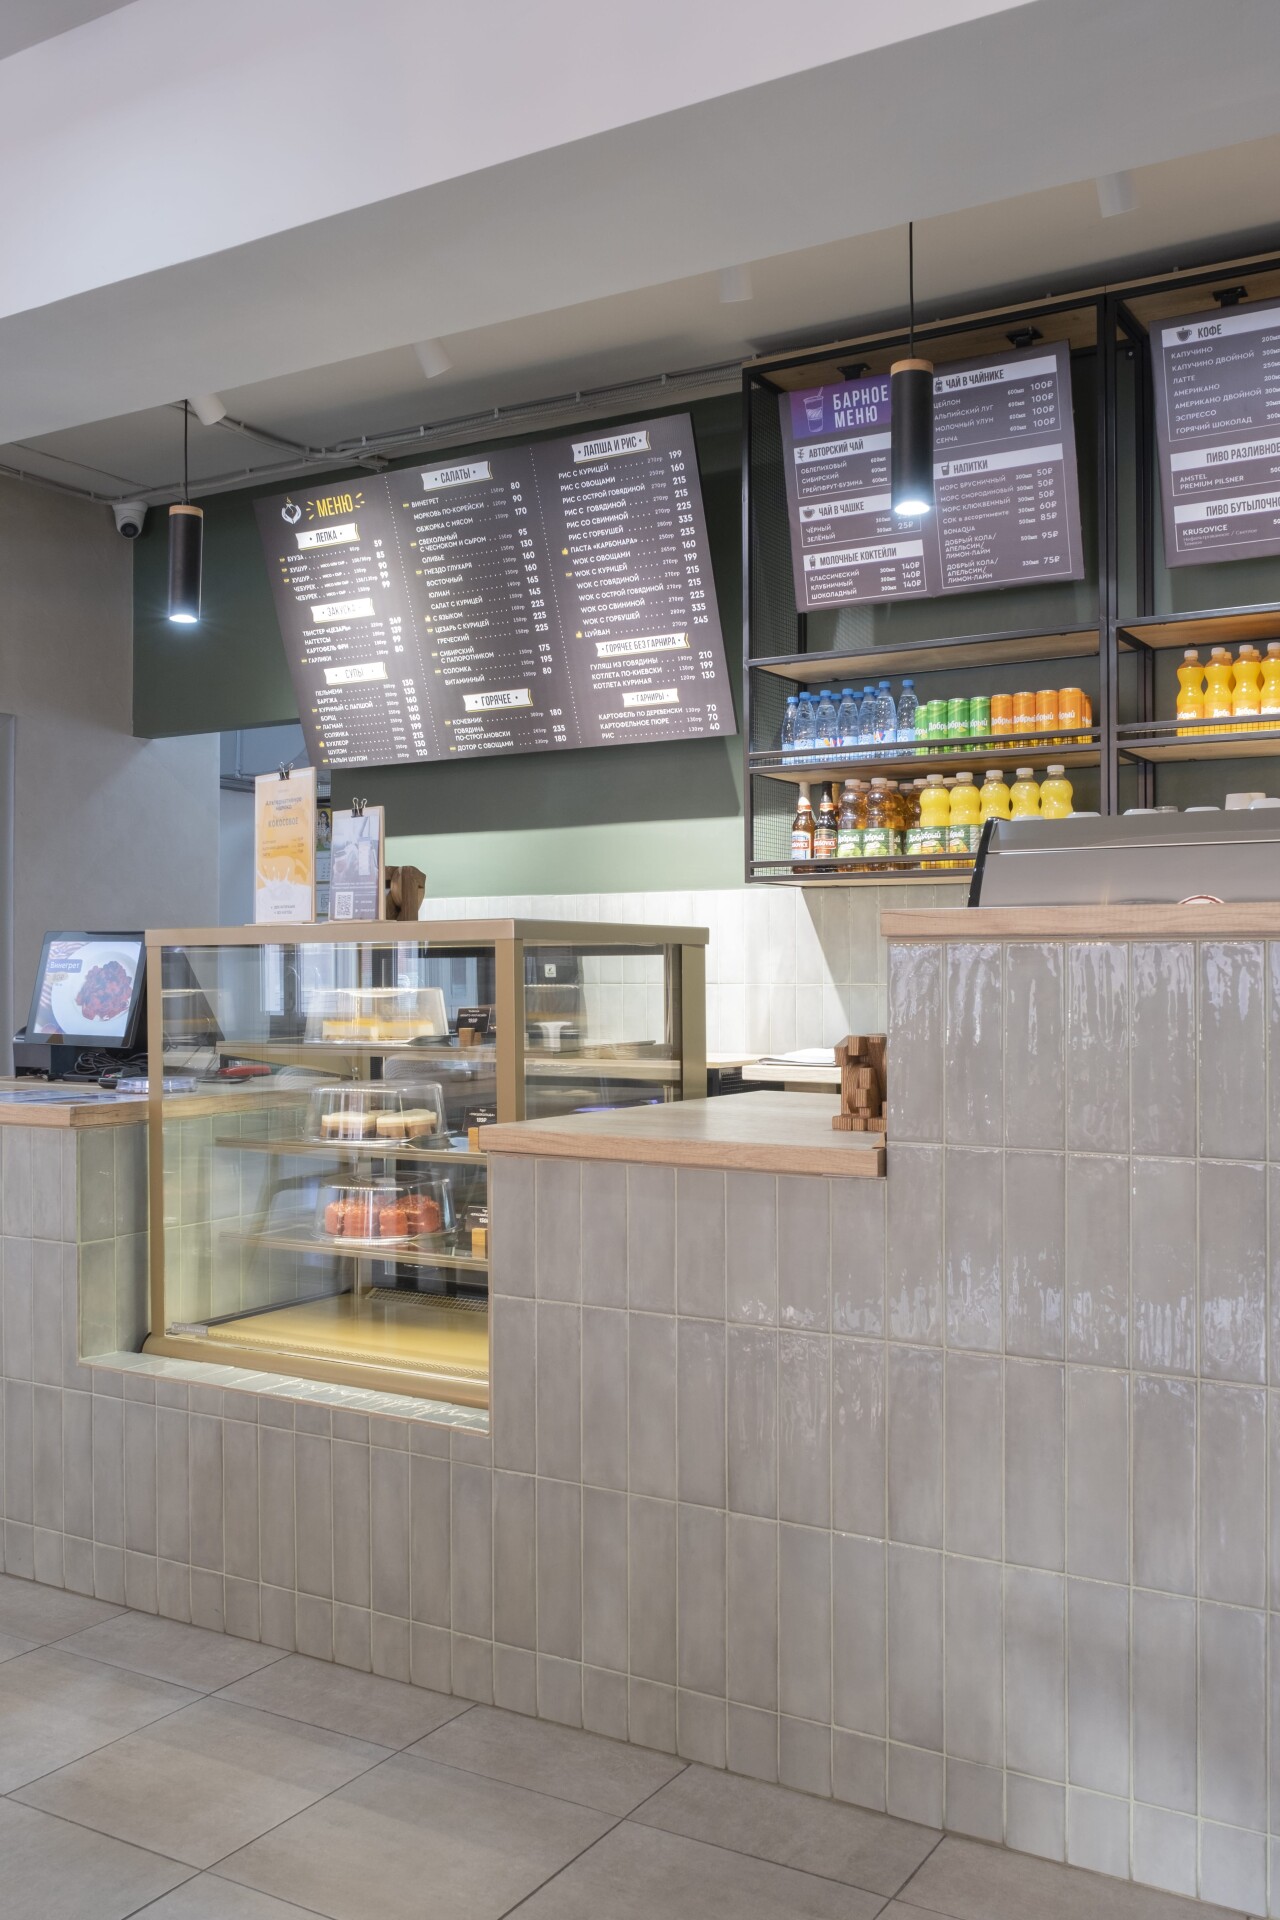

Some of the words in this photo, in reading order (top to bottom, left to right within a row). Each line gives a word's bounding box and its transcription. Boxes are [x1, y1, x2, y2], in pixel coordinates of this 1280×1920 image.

[1198, 324, 1222, 338] КОФЕ
[1171, 346, 1213, 359] КАПУЧИНО
[1172, 359, 1213, 372] КАПУЧИНО
[1216, 350, 1254, 364] ДВОЙНОЙ
[946, 375, 961, 389] ЧАЙ
[963, 377, 967, 385] В
[969, 369, 1004, 384] ЧАЙНИКЕ
[1173, 375, 1195, 384] ЛАТТЕ
[1174, 383, 1220, 397] АМЕРИКАНО
[833, 385, 888, 410] БАРНОЕ
[934, 398, 961, 409] ЦЕЙЛОН
[1175, 396, 1221, 410] АМЕРИКАНО
[1223, 388, 1262, 402] ДВОЙНОЙ
[835, 406, 878, 428] МЕНЮ
[934, 406, 980, 421] АЛЬПИЙСКИЙ
[981, 404, 994, 413] ЛУГ
[1176, 410, 1216, 421] ЭСПРЕССО
[936, 419, 974, 433] МОЛОЧНЫЙ
[976, 418, 993, 426] УЛУН
[1176, 422, 1210, 434] ГОРЯЧИЙ
[1212, 416, 1252, 428] ШОКОЛАД
[584, 442, 612, 456] ЛАПША
[614, 441, 621, 450] И
[622, 436, 637, 449] РИС
[809, 442, 848, 458] АВТОРСКИЙ
[849, 439, 864, 450] ЧАЙ
[1206, 451, 1228, 463] ПИВО
[1231, 442, 1280, 460] РАЗЛИВНОЕ
[800, 461, 847, 474] ОБЛЕПИХОВЫЙ
[954, 460, 988, 474] НАПИТКИ
[441, 468, 470, 483] САЛАТЫ
[802, 474, 839, 484] СИБИРСКИЙ
[1180, 474, 1207, 483] AMSTEL
[583, 490, 606, 501] ОСТРОЙ
[608, 484, 645, 496] ГОВЯДИНОЙ
[673, 476, 686, 484] 215
[802, 480, 863, 493] ГРЕЙПФРУТ-БУЗИНА
[940, 483, 958, 491] МОРС
[960, 475, 1006, 488] БРУСНИЧНЫЙ
[1180, 480, 1212, 490] PREMIUM
[1215, 475, 1244, 485] PILSNER
[316, 494, 353, 517] МЕНЮ
[411, 498, 439, 508] ВИНЕГРЕТ
[819, 506, 832, 516] ЧАЙ
[840, 502, 864, 513] ЧАШКЕ
[414, 511, 441, 520] МОРКОВЬ
[442, 503, 484, 516] ПО-КОРЕЙСКИ
[1206, 504, 1228, 516] ПИВО
[944, 526, 975, 535] BONAQUA
[1182, 524, 1228, 536] KRUSOVICE
[316, 530, 337, 543] ЛЕПКА
[419, 532, 458, 546] СВЕКОЛЬНЫЙ
[593, 539, 638, 549] «КАРБОНАРА»
[680, 527, 695, 536] 235
[945, 536, 972, 546] ДОБРЫЙ
[946, 542, 984, 552] АПЕЛЬСИН/
[422, 555, 444, 563] ОЛИВЬЕ
[820, 552, 859, 566] МОЛОЧНЫЕ
[861, 547, 896, 562] КОКТЕЙЛИ
[946, 548, 990, 559] ЛИМОН-ЛАЙМ
[424, 566, 446, 575] ГНЕЗДО
[447, 562, 472, 571] ГЛУХАРЯ
[947, 561, 974, 571] ДОБРЫЙ
[948, 566, 986, 577] АПЕЛЬСИН/
[427, 575, 463, 587] ВОСТОЧНЫЙ
[810, 570, 860, 582] КЛАССИЧЕСКИЙ
[948, 573, 992, 584] ЛИМОН-ЛАЙМ
[293, 584, 316, 592] ЧЕБУРЕК
[811, 580, 853, 590] КЛУБНИЧНЫЙ
[429, 590, 450, 598] ЮЛИАН
[812, 589, 857, 600] ШОКОЛАДНЫЙ
[609, 597, 645, 609] СВИНИНОЙ
[439, 612, 463, 620] ЯЗЫКОМ
[437, 634, 470, 644] ГРЕЧЕСКИЙ
[606, 644, 632, 653] ГОРЯЧЕЕ
[634, 641, 646, 649] БЕЗ
[647, 637, 676, 648] ГАРНИРА
[440, 646, 474, 657] СИБИРСКИЙ
[623, 658, 658, 667] ГОВЯДИНЫ
[699, 651, 712, 659] 210
[345, 669, 364, 679] СУПЫ
[445, 675, 485, 685] ВИТАМИННЫЙ
[592, 672, 620, 680] КОТЛЕТА
[621, 668, 662, 676] ПО-КИЕВСКИ
[623, 678, 652, 686] КУРИНАЯ
[315, 688, 342, 696] ПЕЛЬМЕНИ
[637, 693, 664, 702] ГАРНИРЫ
[481, 694, 512, 706] ГОРЯЧЕЕ
[599, 711, 635, 720] КАРТОФЕЛЬ
[646, 708, 682, 716] ДЕРЕВЕНСКИ
[600, 720, 649, 729] КАРТОФЕЛЬНОЕ
[456, 732, 511, 741] ПО-СТРОГАНОВСКИ
[50, 961, 80, 970] Винегрет
